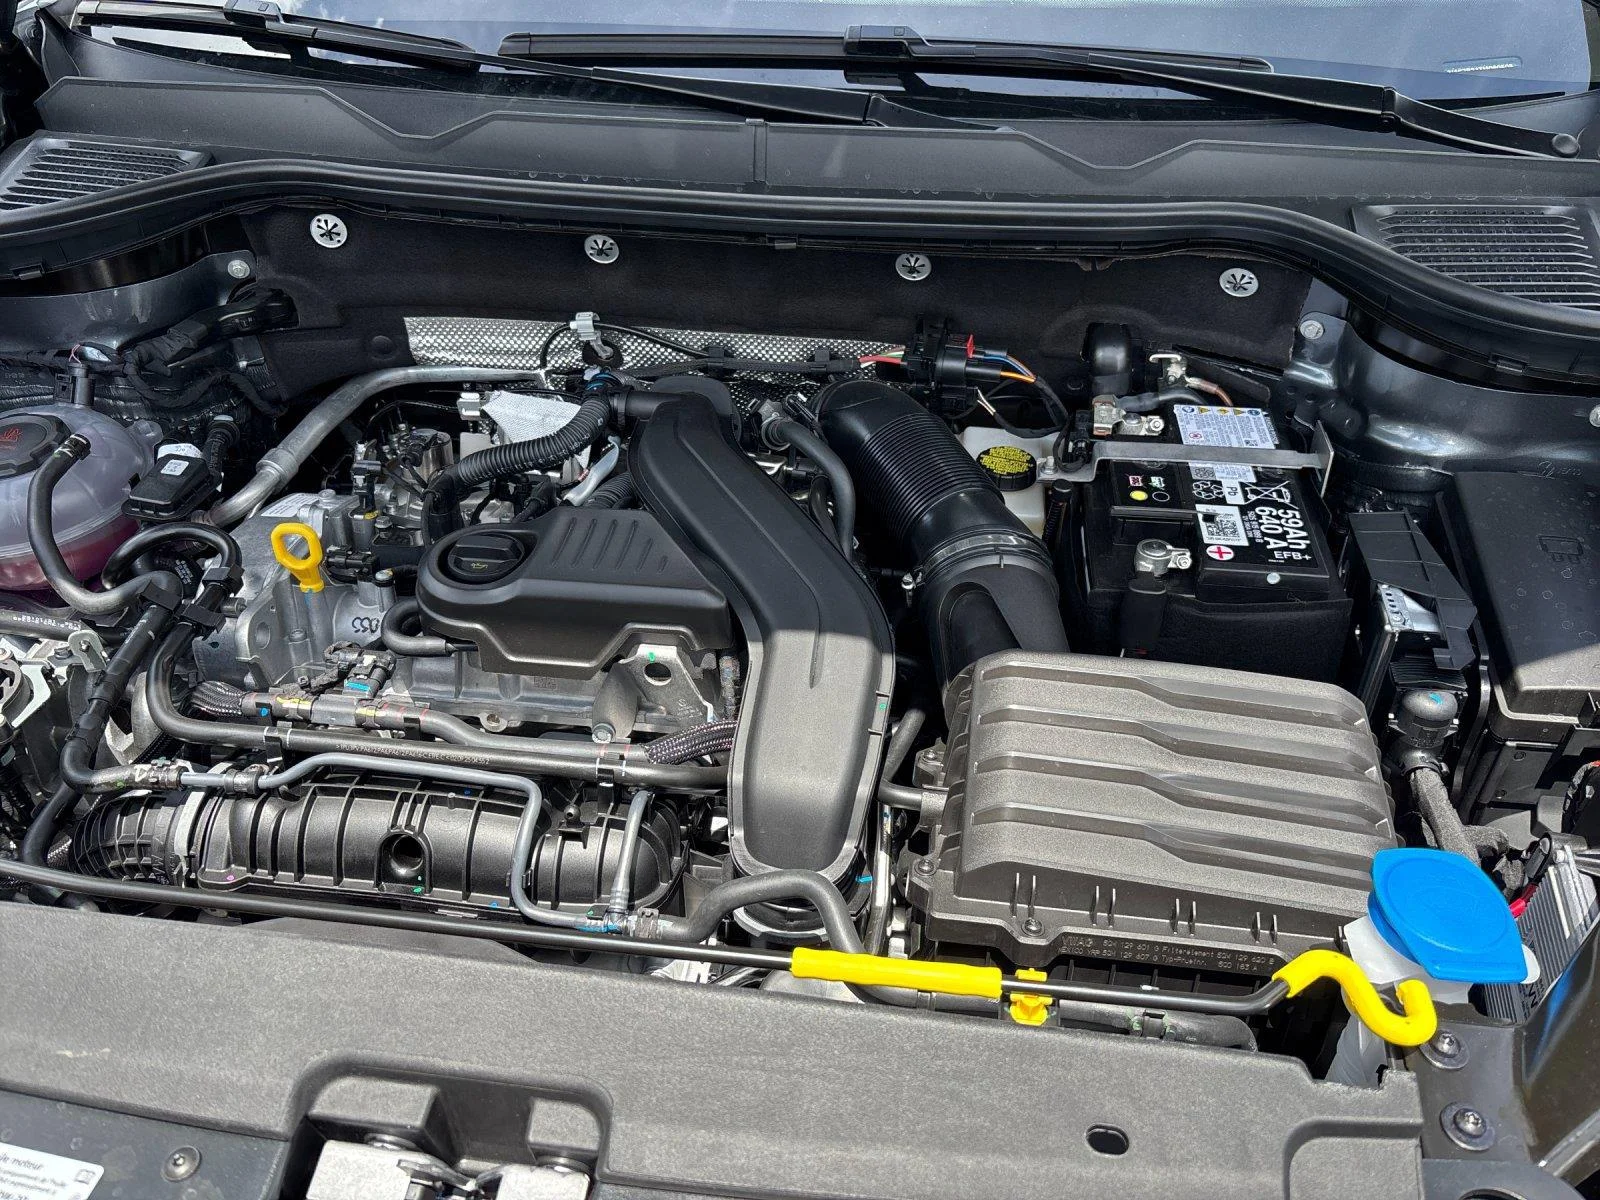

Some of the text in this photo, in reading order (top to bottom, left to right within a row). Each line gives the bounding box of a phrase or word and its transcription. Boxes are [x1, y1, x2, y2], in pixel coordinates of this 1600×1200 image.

[1226, 486, 1238, 497] Pb
[1255, 506, 1283, 535] 640
[1277, 509, 1311, 550] 59Ah
[1263, 536, 1288, 550] A
[1273, 550, 1312, 561] EFB+
